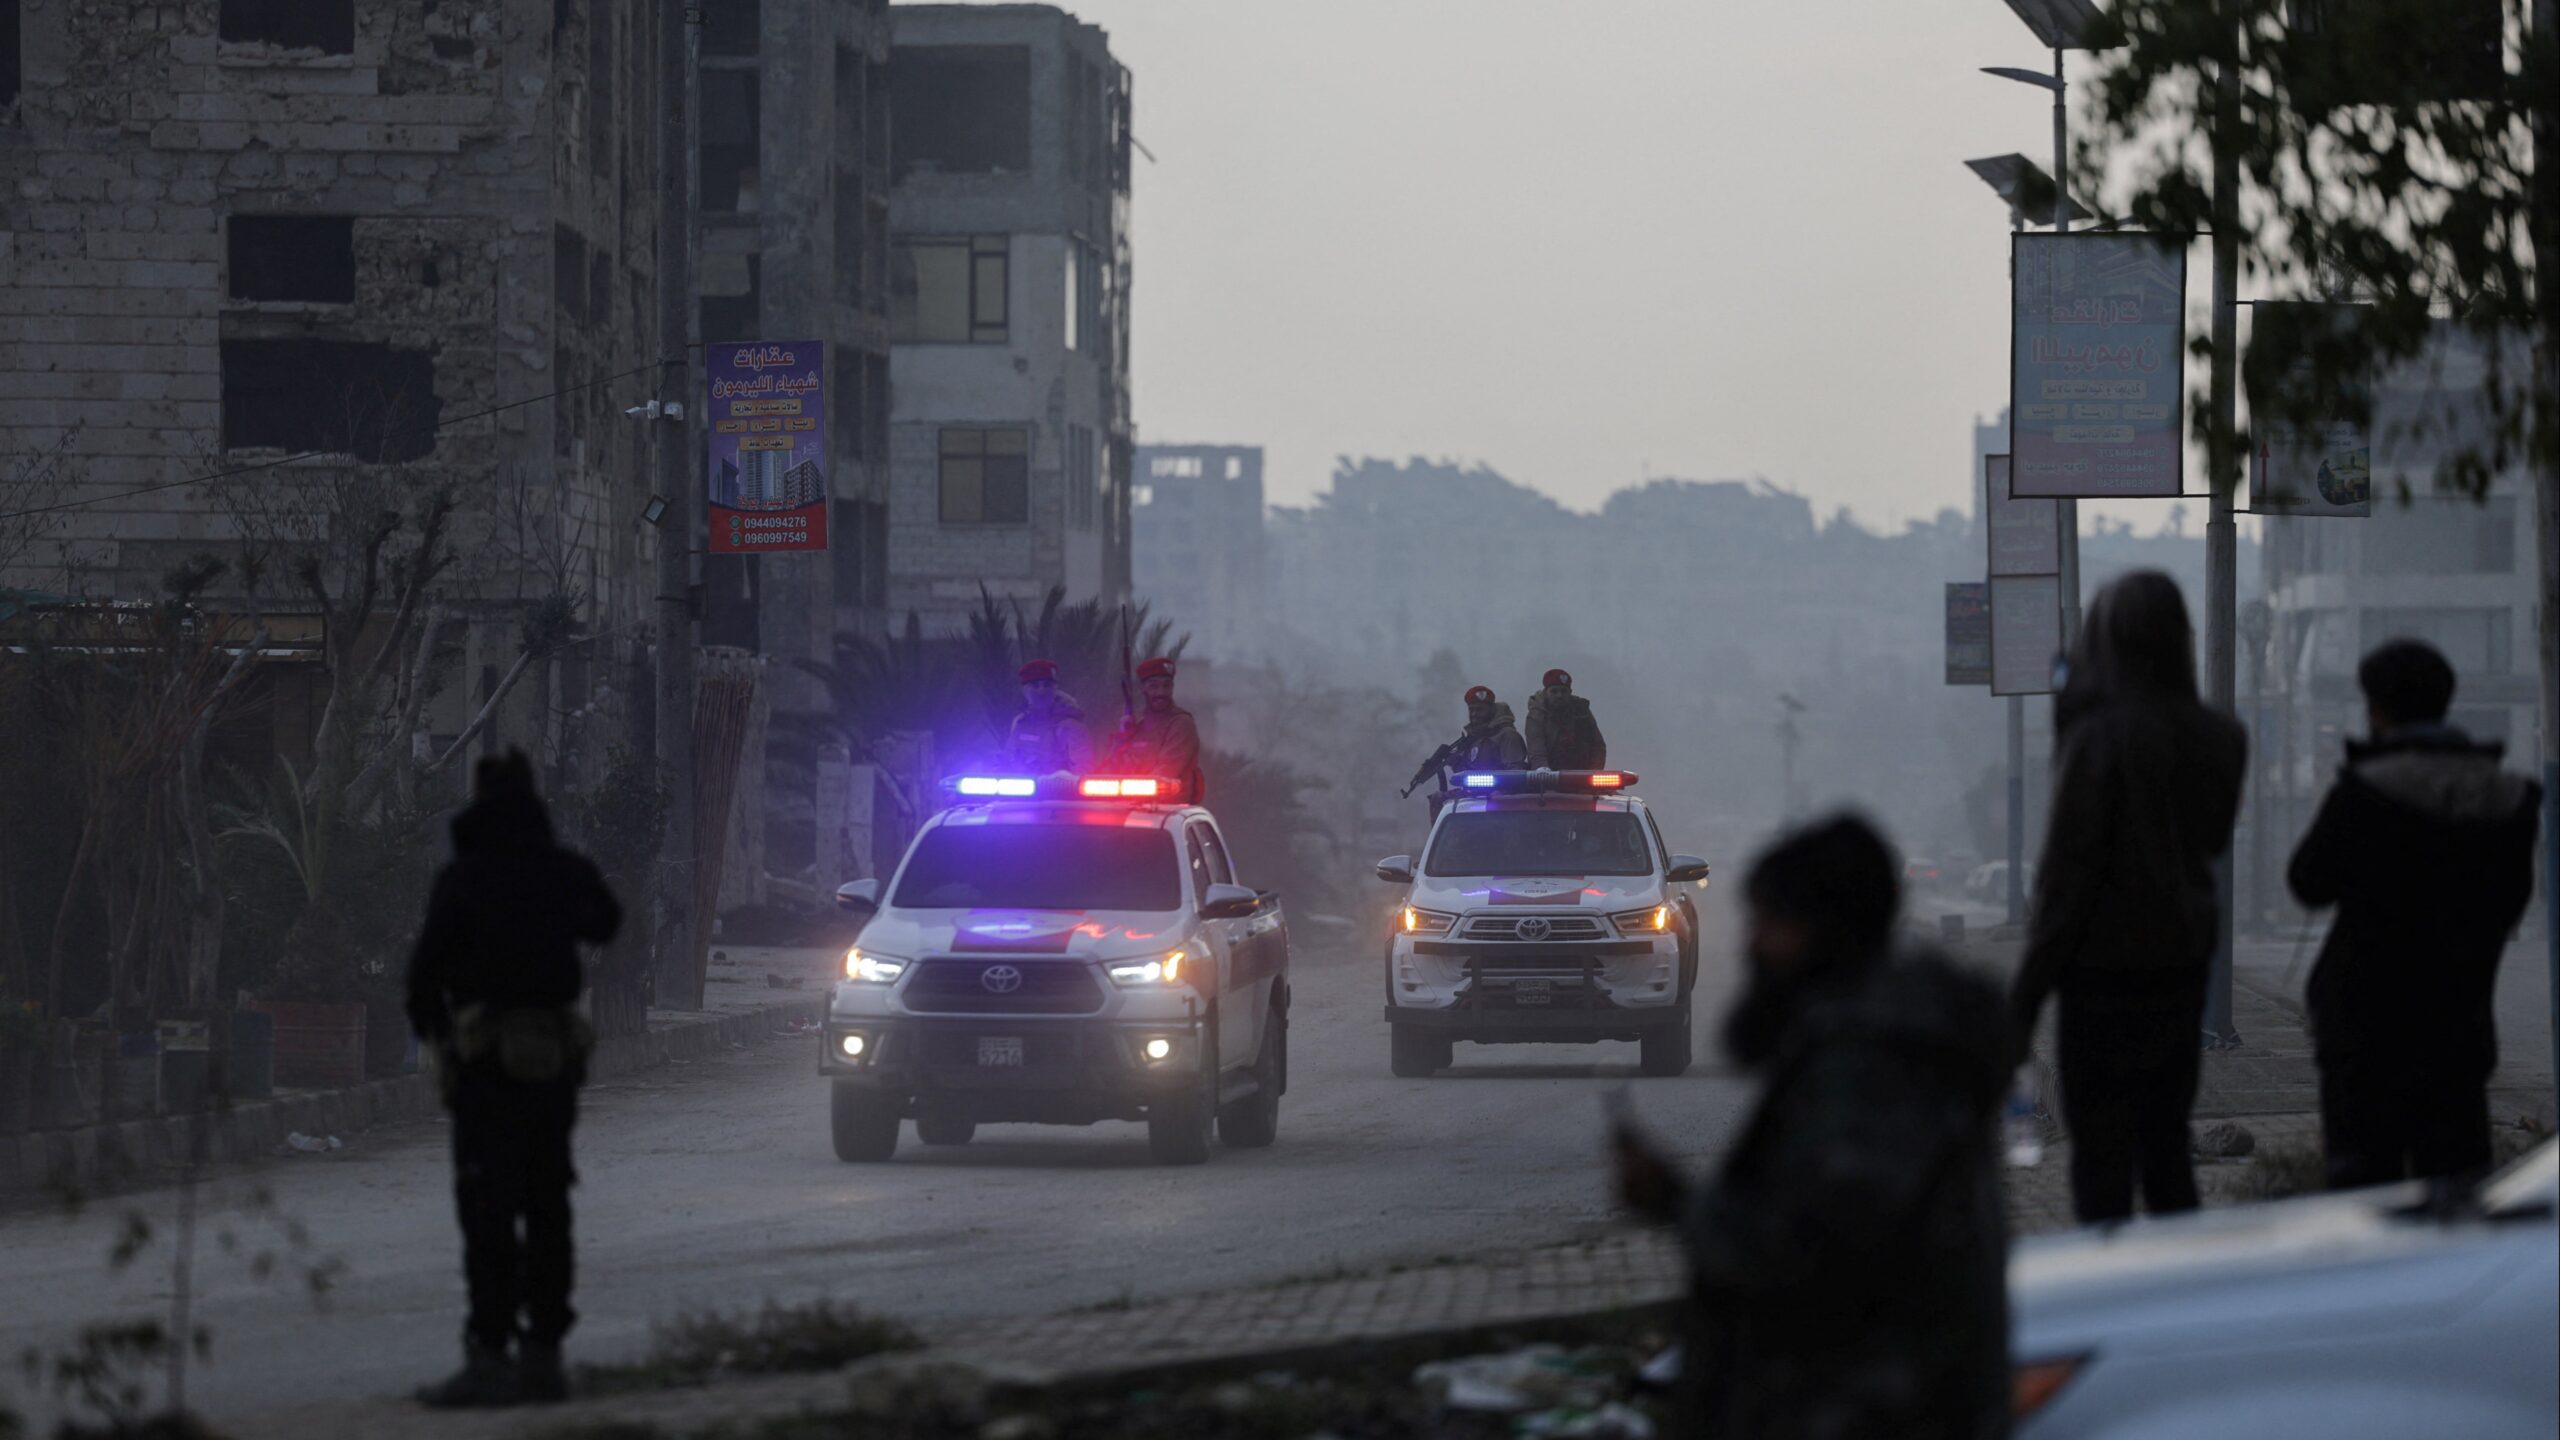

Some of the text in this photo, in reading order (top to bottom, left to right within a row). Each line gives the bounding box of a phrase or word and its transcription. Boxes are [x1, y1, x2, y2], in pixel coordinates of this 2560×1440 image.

[733, 345, 795, 372] عقارات
[712, 370, 819, 399] شهباء الليرمون
[744, 516, 807, 529] 0944094276
[744, 531, 807, 544] 0960997549
